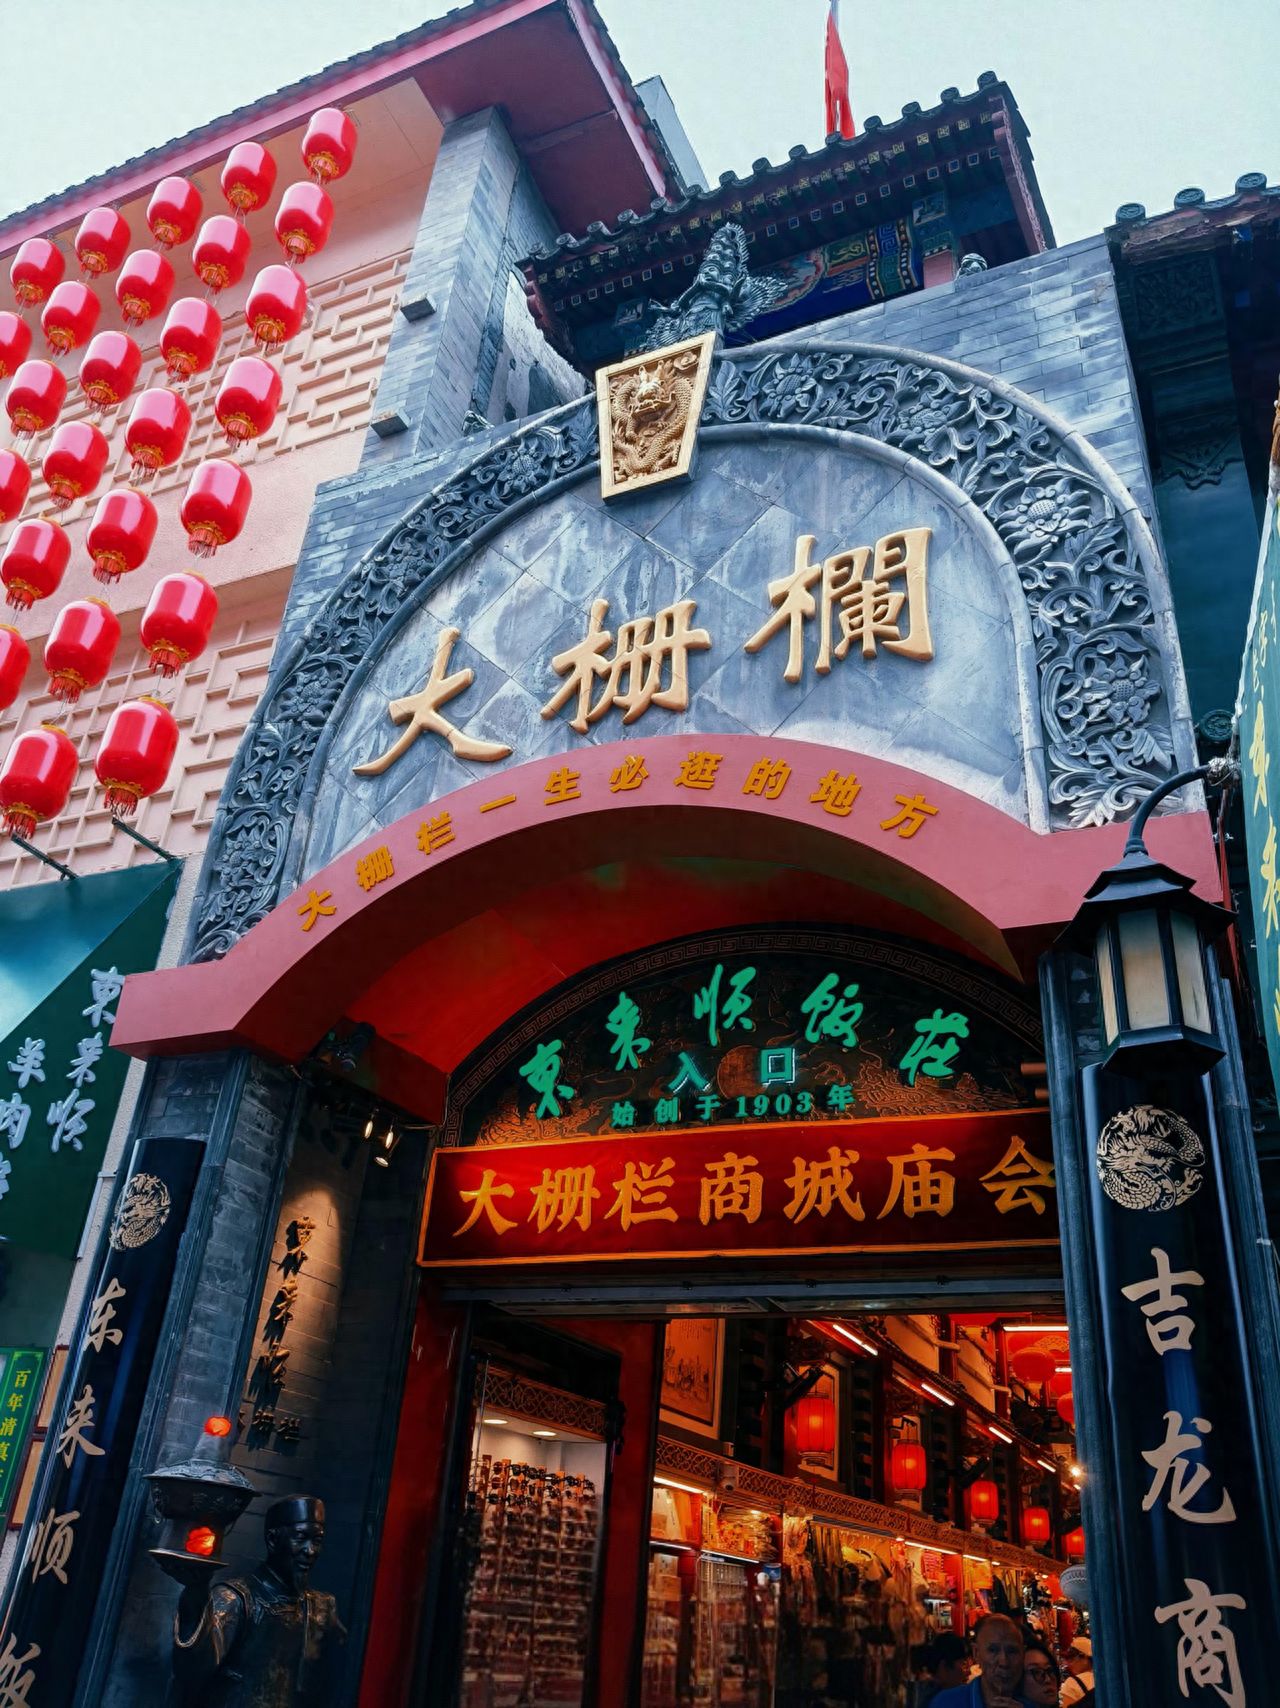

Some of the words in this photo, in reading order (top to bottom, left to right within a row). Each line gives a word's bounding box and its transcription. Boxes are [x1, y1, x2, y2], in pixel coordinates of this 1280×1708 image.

[298, 750, 940, 932] 大栅栏一生必逛的地方
[667, 1047, 797, 1094] 入口
[453, 1134, 1057, 1237] 大栅栏商城庙会
[1120, 1247, 1247, 1708] 吉龙商
